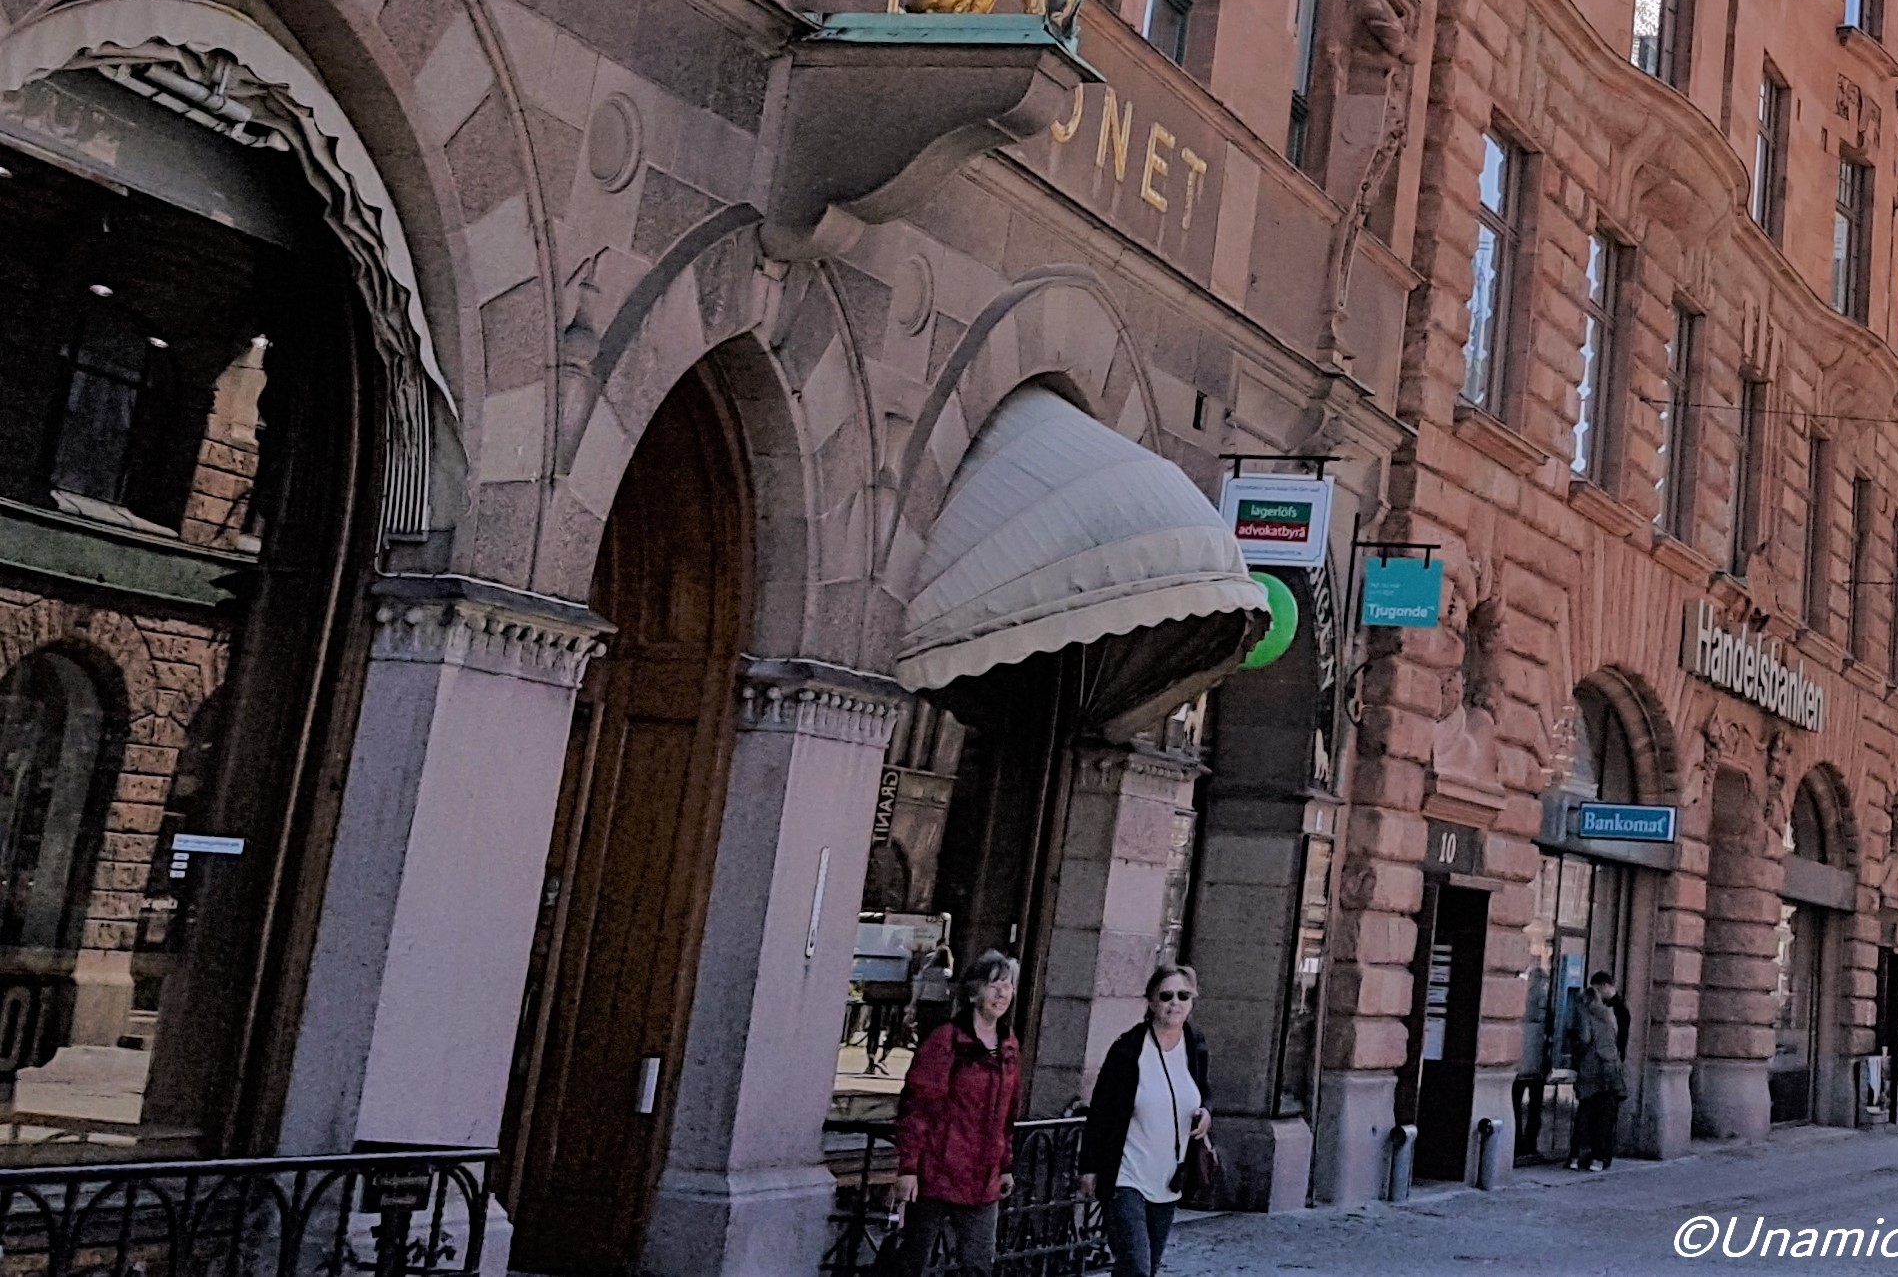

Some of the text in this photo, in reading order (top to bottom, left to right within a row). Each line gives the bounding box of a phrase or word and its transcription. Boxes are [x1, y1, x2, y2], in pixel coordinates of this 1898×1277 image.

[1250, 504, 1298, 519] lagerlöfs
[1695, 597, 1824, 734] Handelsbanken
[1583, 810, 1669, 835] Bankomat
[1438, 832, 1457, 865] 10
